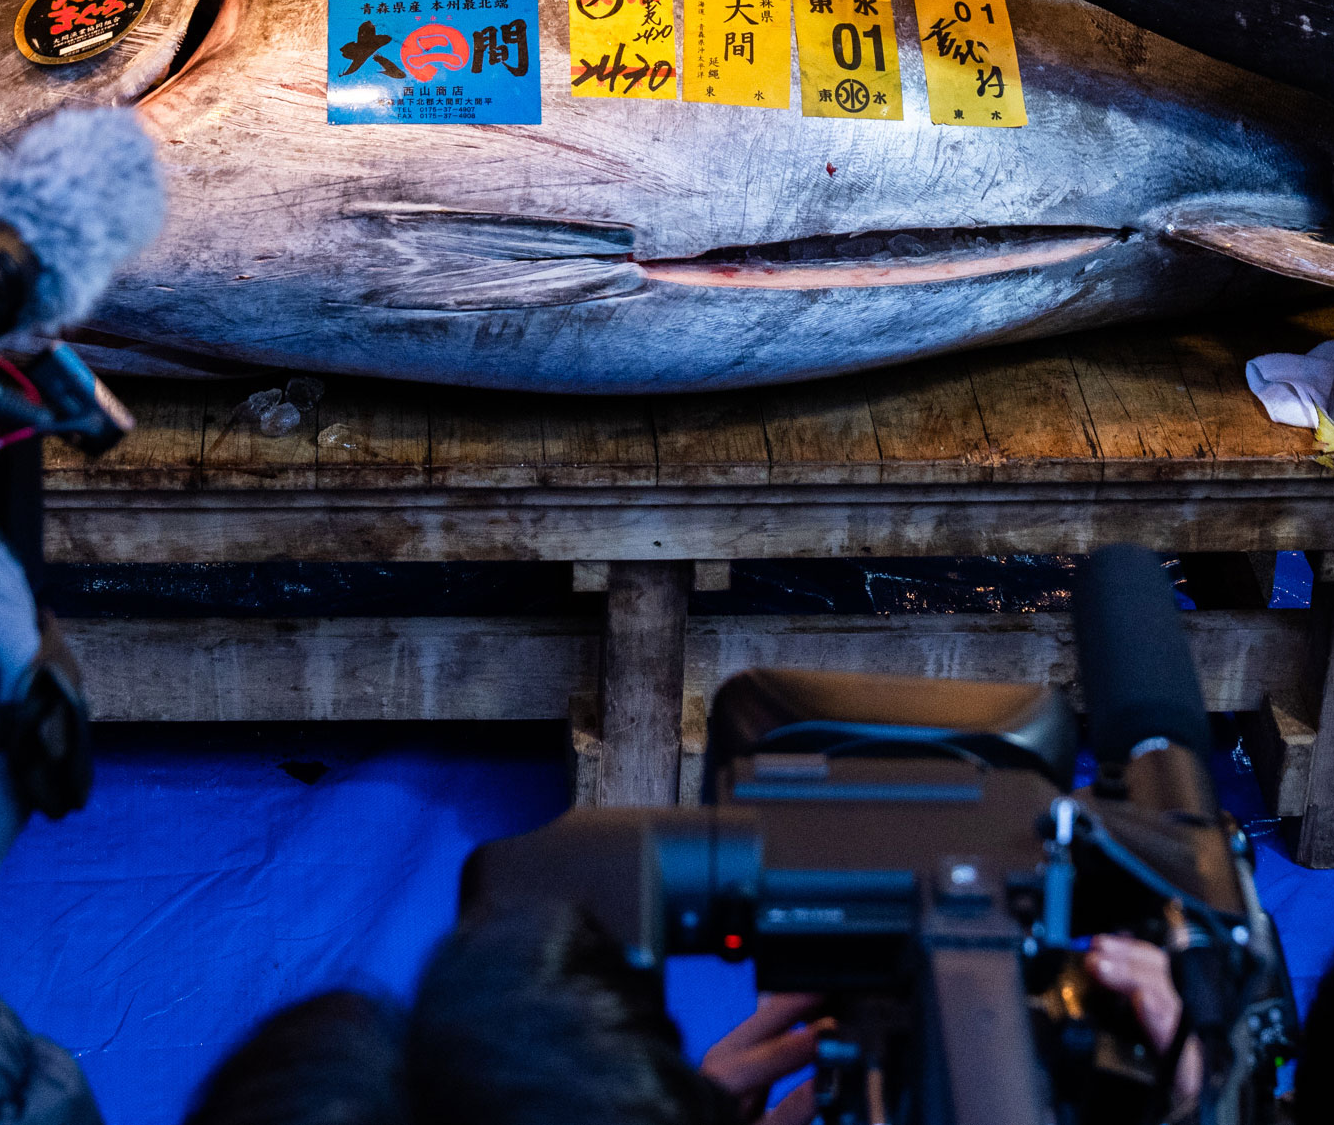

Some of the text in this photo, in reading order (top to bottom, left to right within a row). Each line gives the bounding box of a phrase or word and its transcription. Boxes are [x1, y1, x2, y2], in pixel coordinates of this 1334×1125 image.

[360, 1, 423, 14] 青森県産
[954, 1, 995, 24] 01
[832, 22, 886, 72] 01
[403, 86, 464, 96] 西山商店
